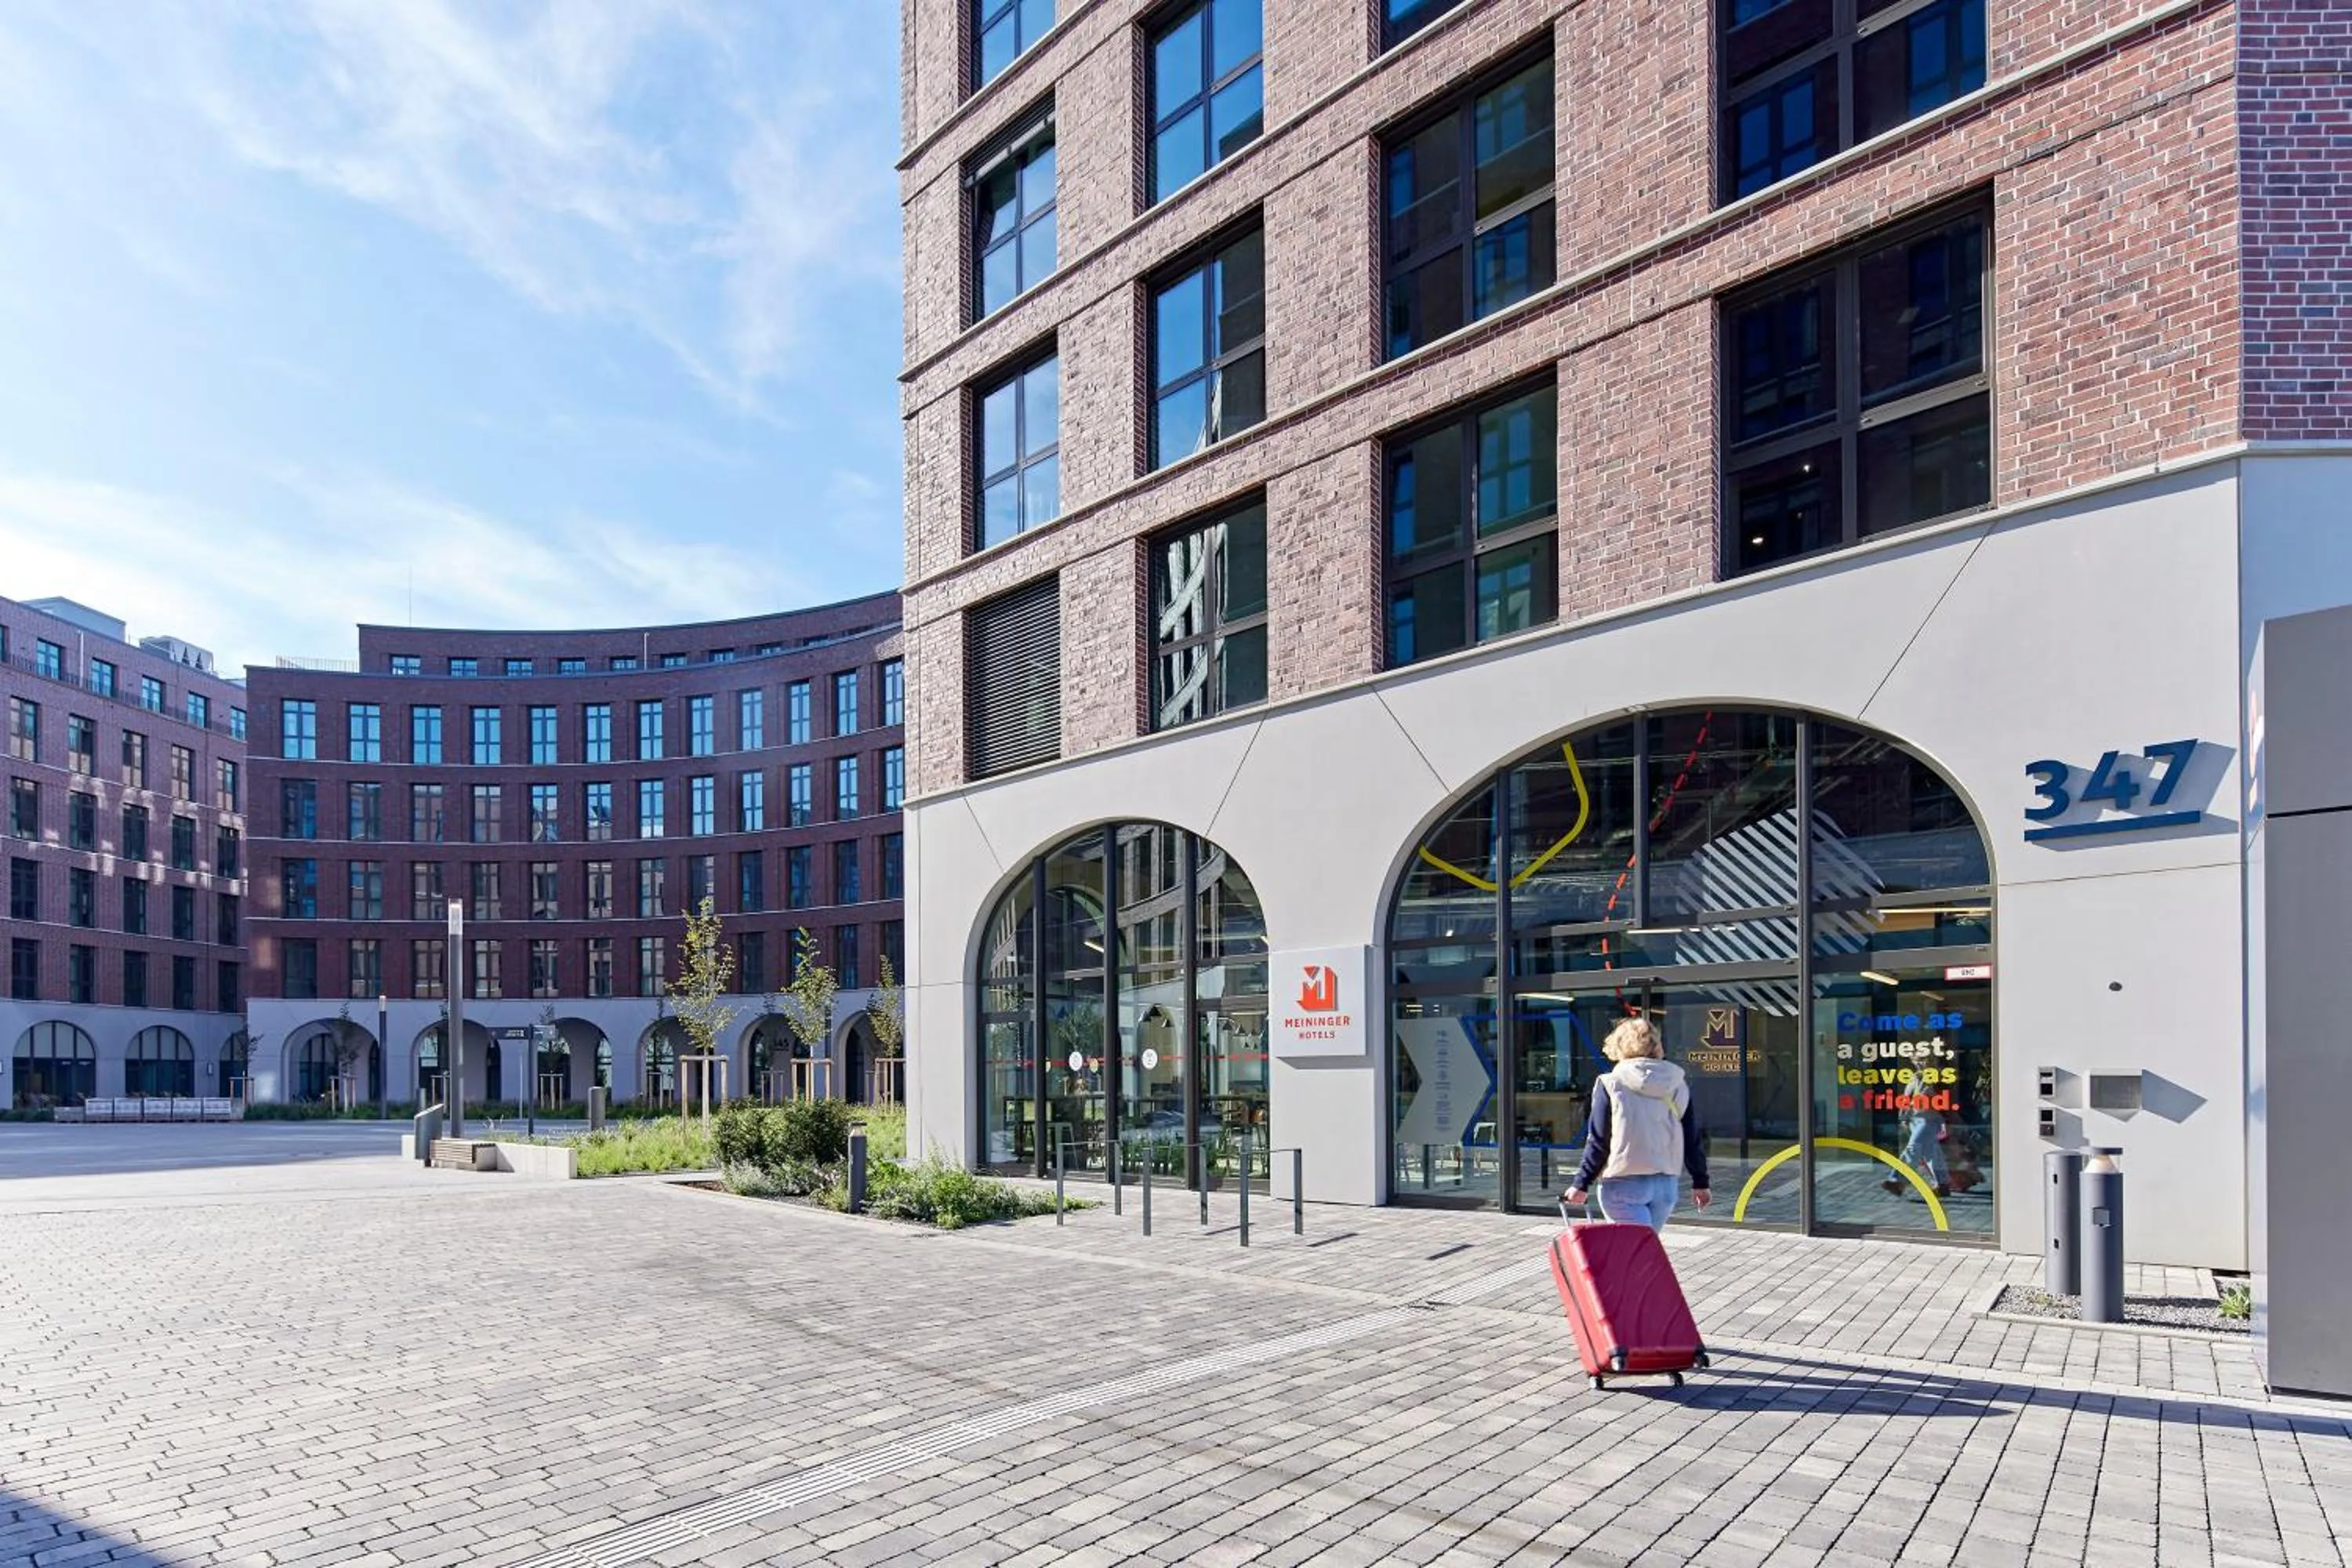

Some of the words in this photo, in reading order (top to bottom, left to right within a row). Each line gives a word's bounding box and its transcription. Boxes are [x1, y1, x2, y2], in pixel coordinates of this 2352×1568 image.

[2024, 738, 2198, 821] 347
[1284, 1015, 1350, 1028] MEININGER
[1838, 1011, 1920, 1032] Come
[1926, 1012, 1963, 1030] as
[1298, 1030, 1336, 1040] HOTELS
[1837, 1043, 1853, 1059] a
[1860, 1036, 1955, 1062] guest,
[1837, 1065, 1914, 1085] leave
[1922, 1066, 1957, 1084] as
[1838, 1094, 1855, 1110] a
[1862, 1088, 1960, 1112] friend.
